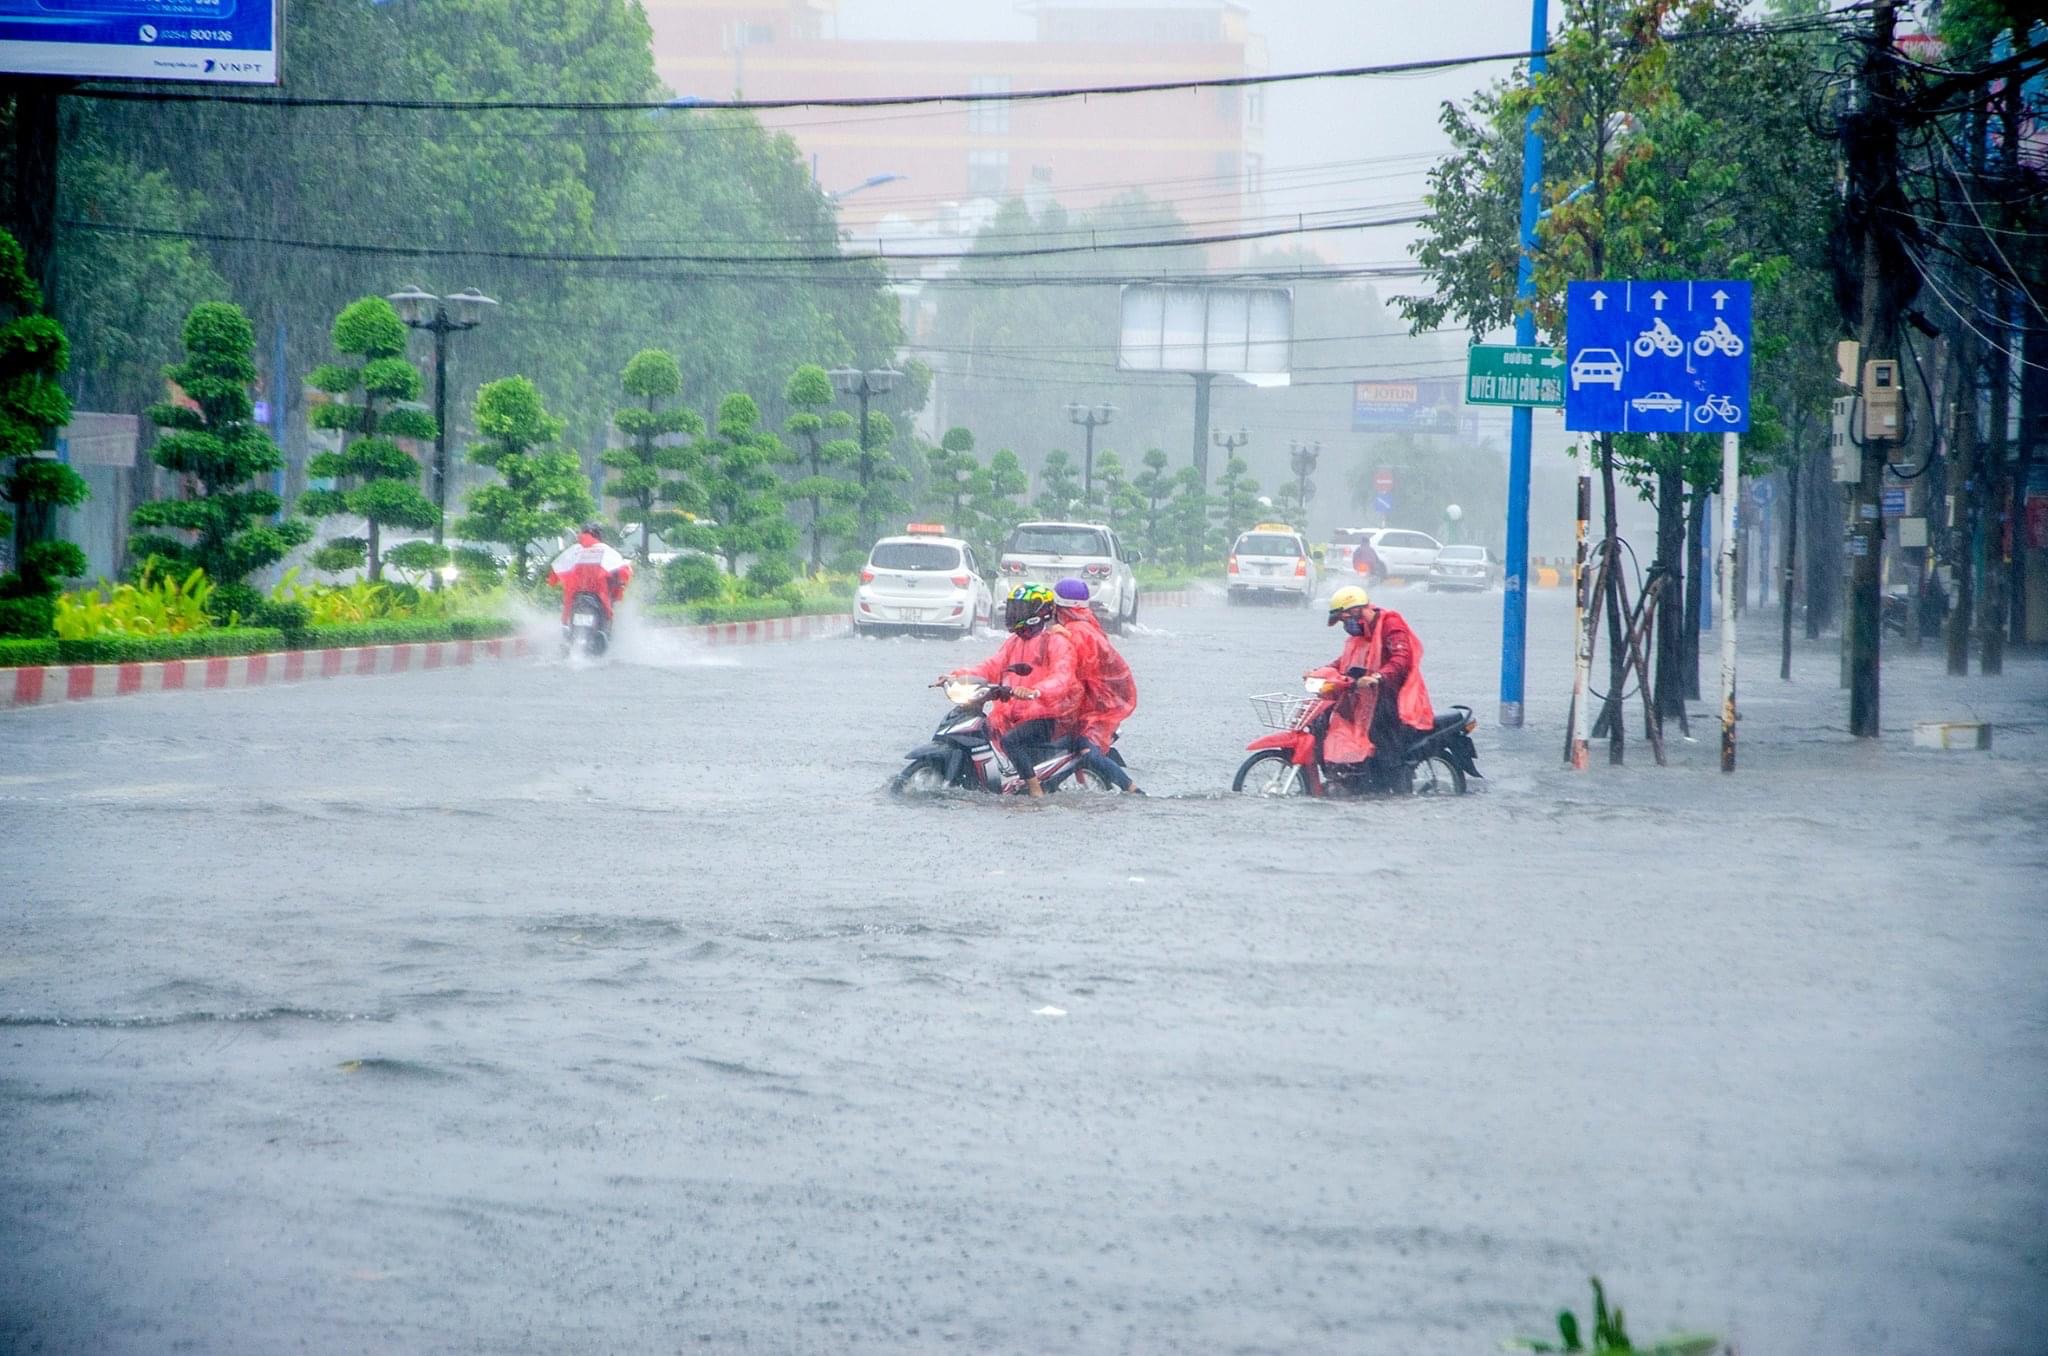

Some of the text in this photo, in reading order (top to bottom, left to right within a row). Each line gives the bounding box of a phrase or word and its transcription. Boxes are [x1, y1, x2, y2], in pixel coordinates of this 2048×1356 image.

[190, 29, 233, 42] 800126
[219, 63, 262, 73] VNPT
[1374, 387, 1415, 400] JOTUN
